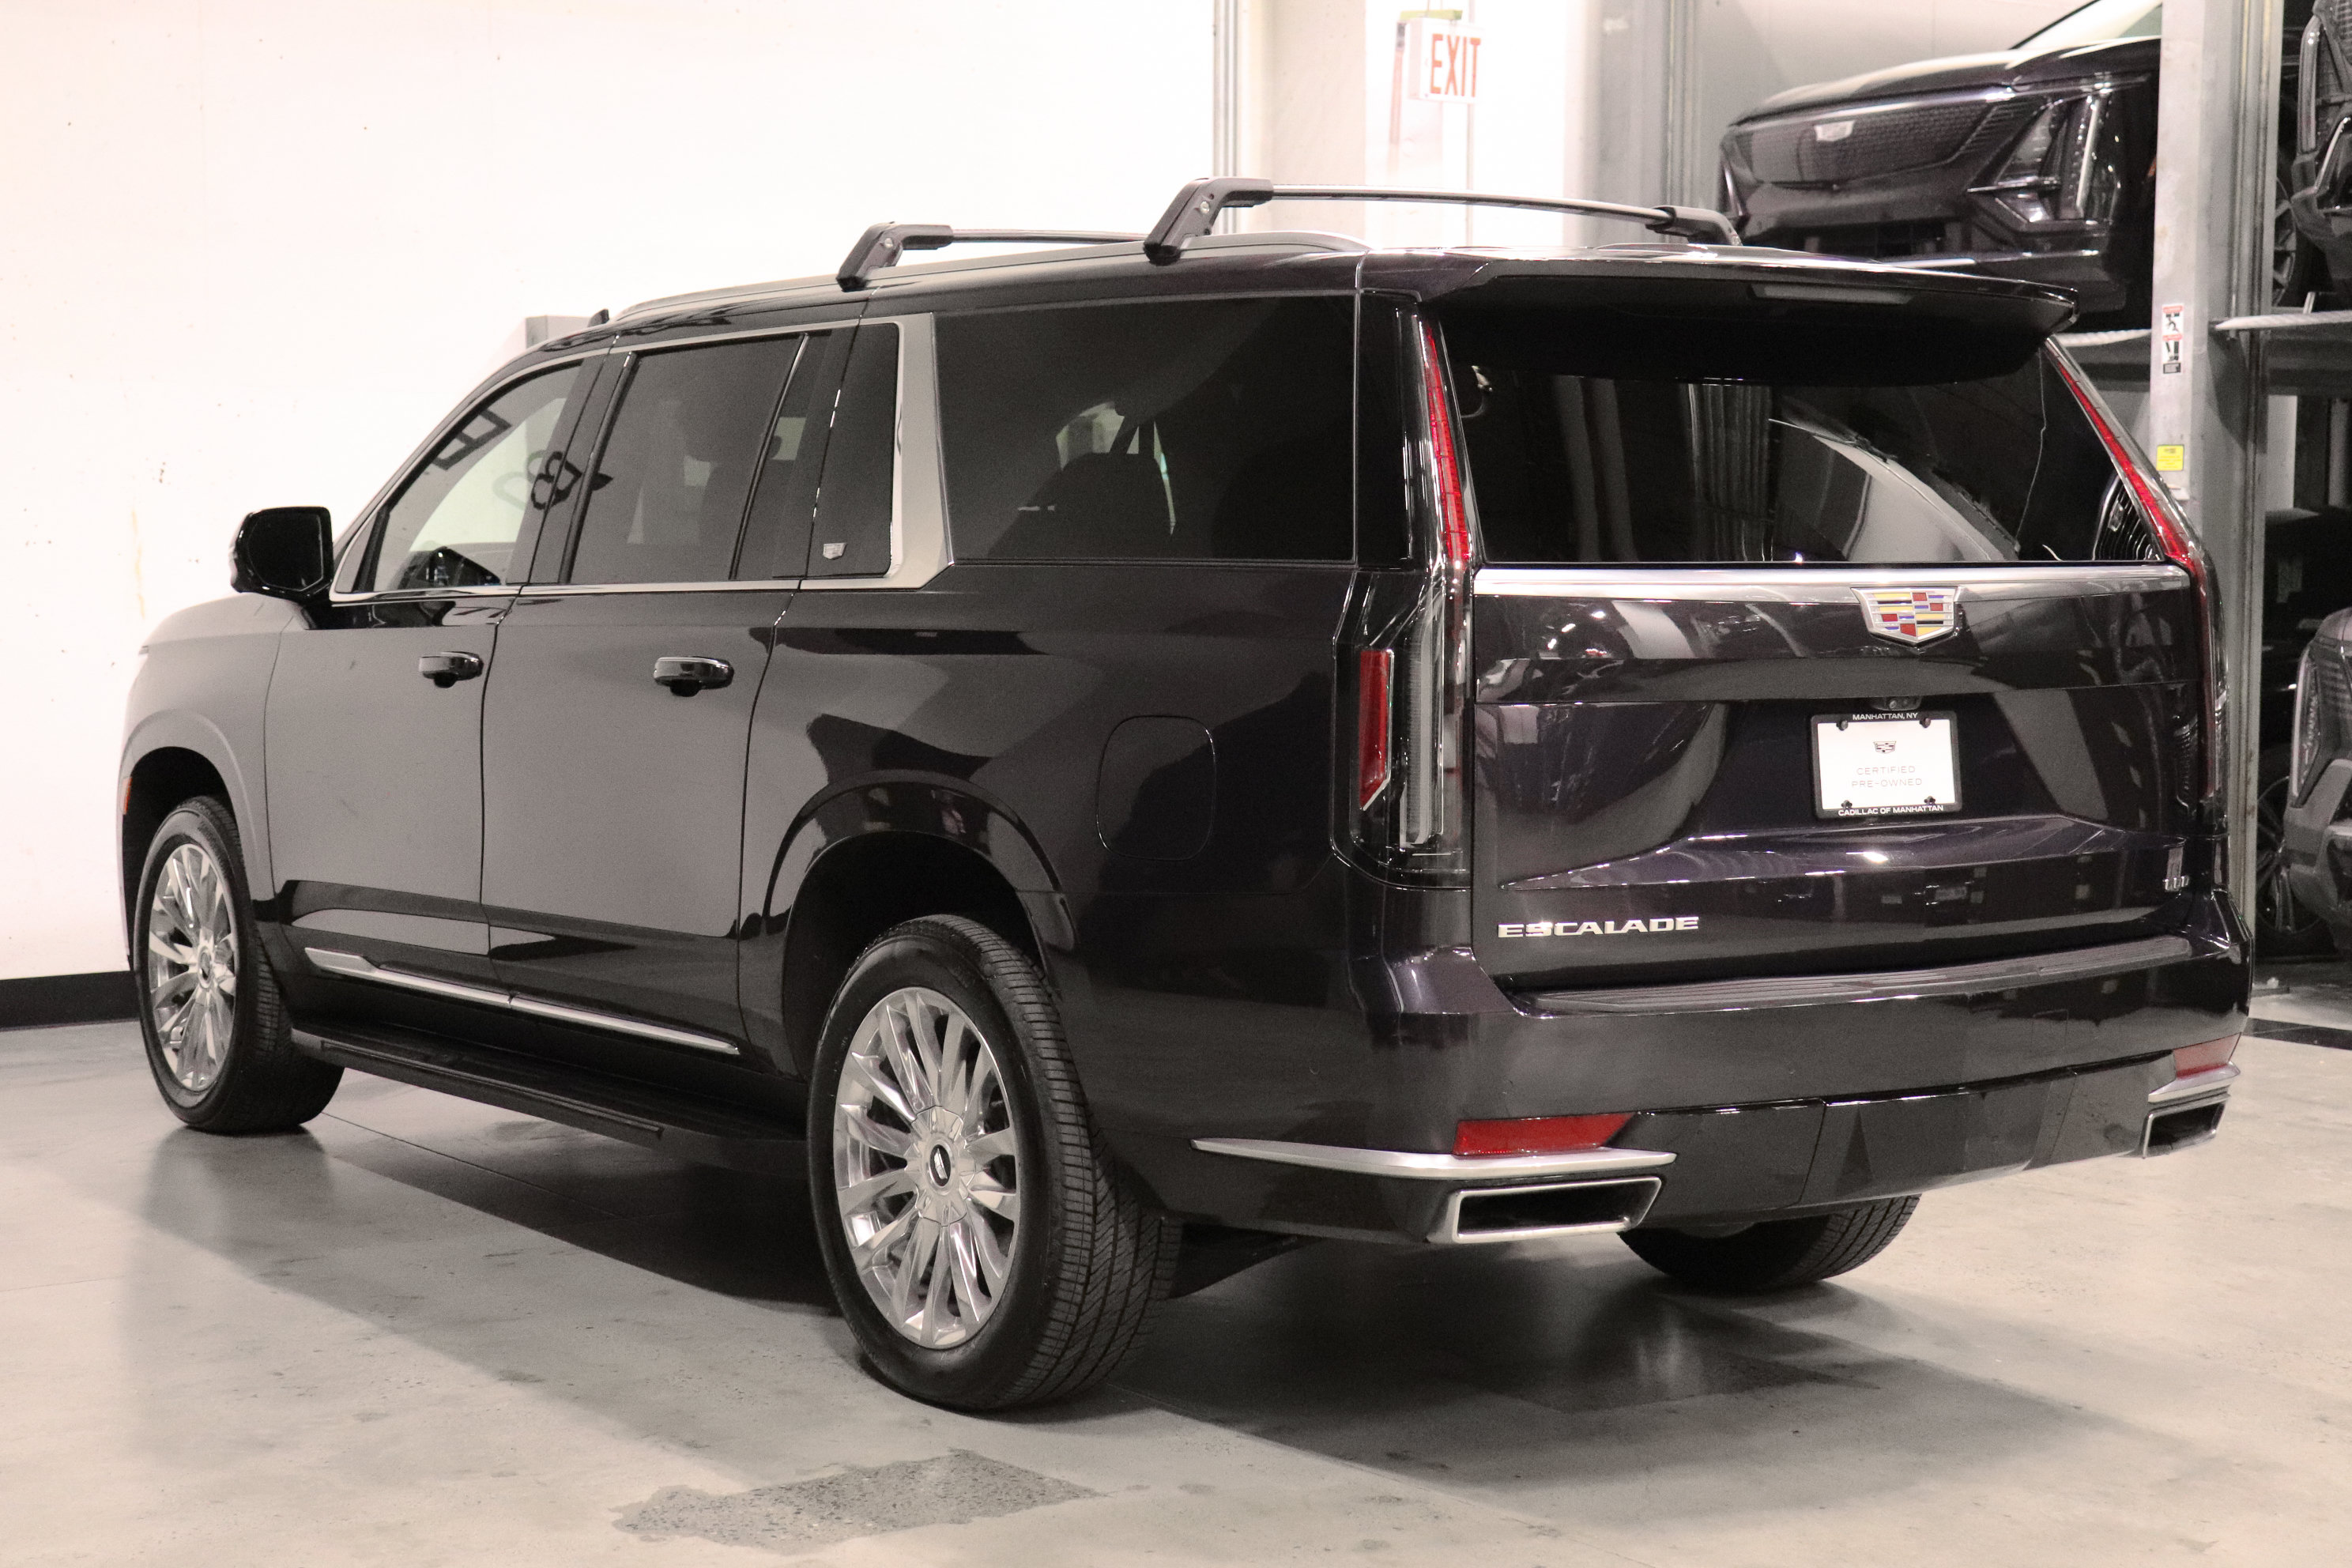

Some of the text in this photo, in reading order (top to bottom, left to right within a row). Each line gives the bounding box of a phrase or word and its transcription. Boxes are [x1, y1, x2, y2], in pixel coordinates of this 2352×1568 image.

[1430, 32, 1482, 98] EXIT
[1856, 766, 1916, 775] CERTIFIED
[1852, 778, 1923, 788] PRE-OWNED
[1893, 805, 1944, 813] MANHATTAN
[1498, 916, 1699, 938] ESCALADE
